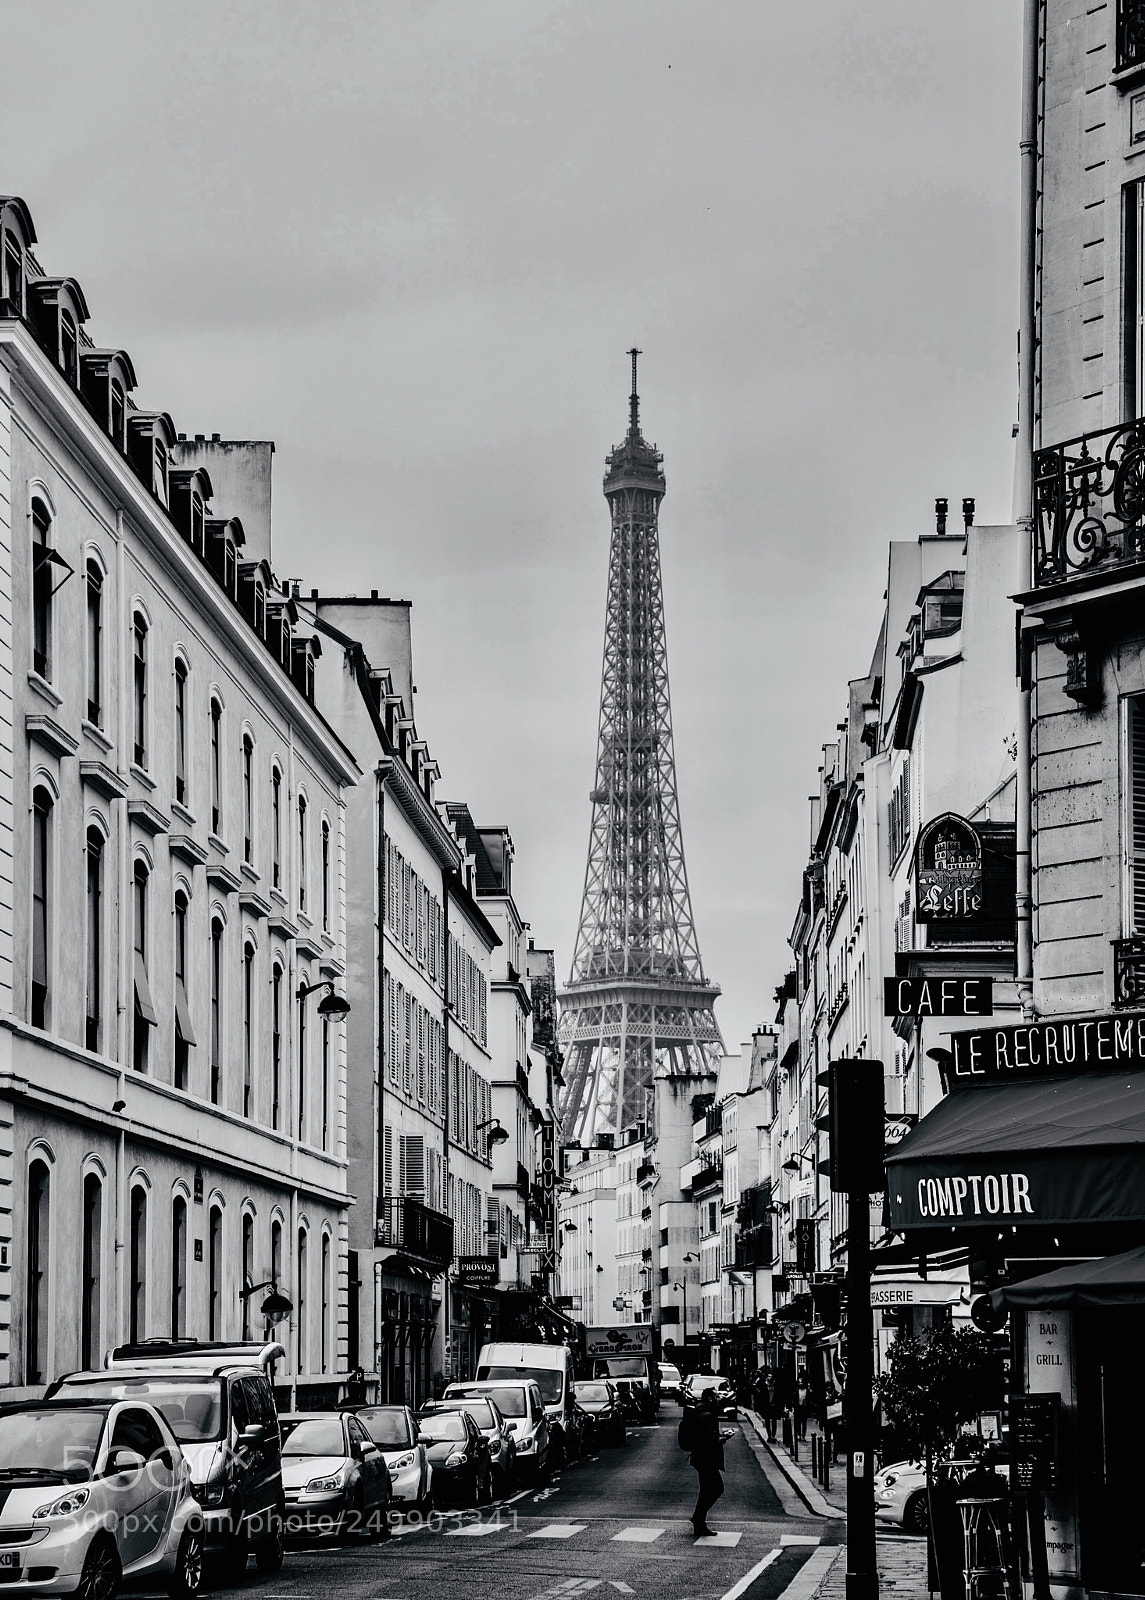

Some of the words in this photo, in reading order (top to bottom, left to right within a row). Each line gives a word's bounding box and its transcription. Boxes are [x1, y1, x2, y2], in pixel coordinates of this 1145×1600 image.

[919, 884, 981, 915] Leffe
[898, 979, 980, 1014] CAFE
[954, 1036, 986, 1076] LE
[542, 1125, 554, 1268] THOUMIEUX
[917, 1173, 1035, 1217] COMPTOIR
[461, 1263, 496, 1271] PROVOST
[1039, 1323, 1058, 1335] BAR
[1036, 1354, 1063, 1366] GRILL
[1046, 1541, 1075, 1554] mpagne
